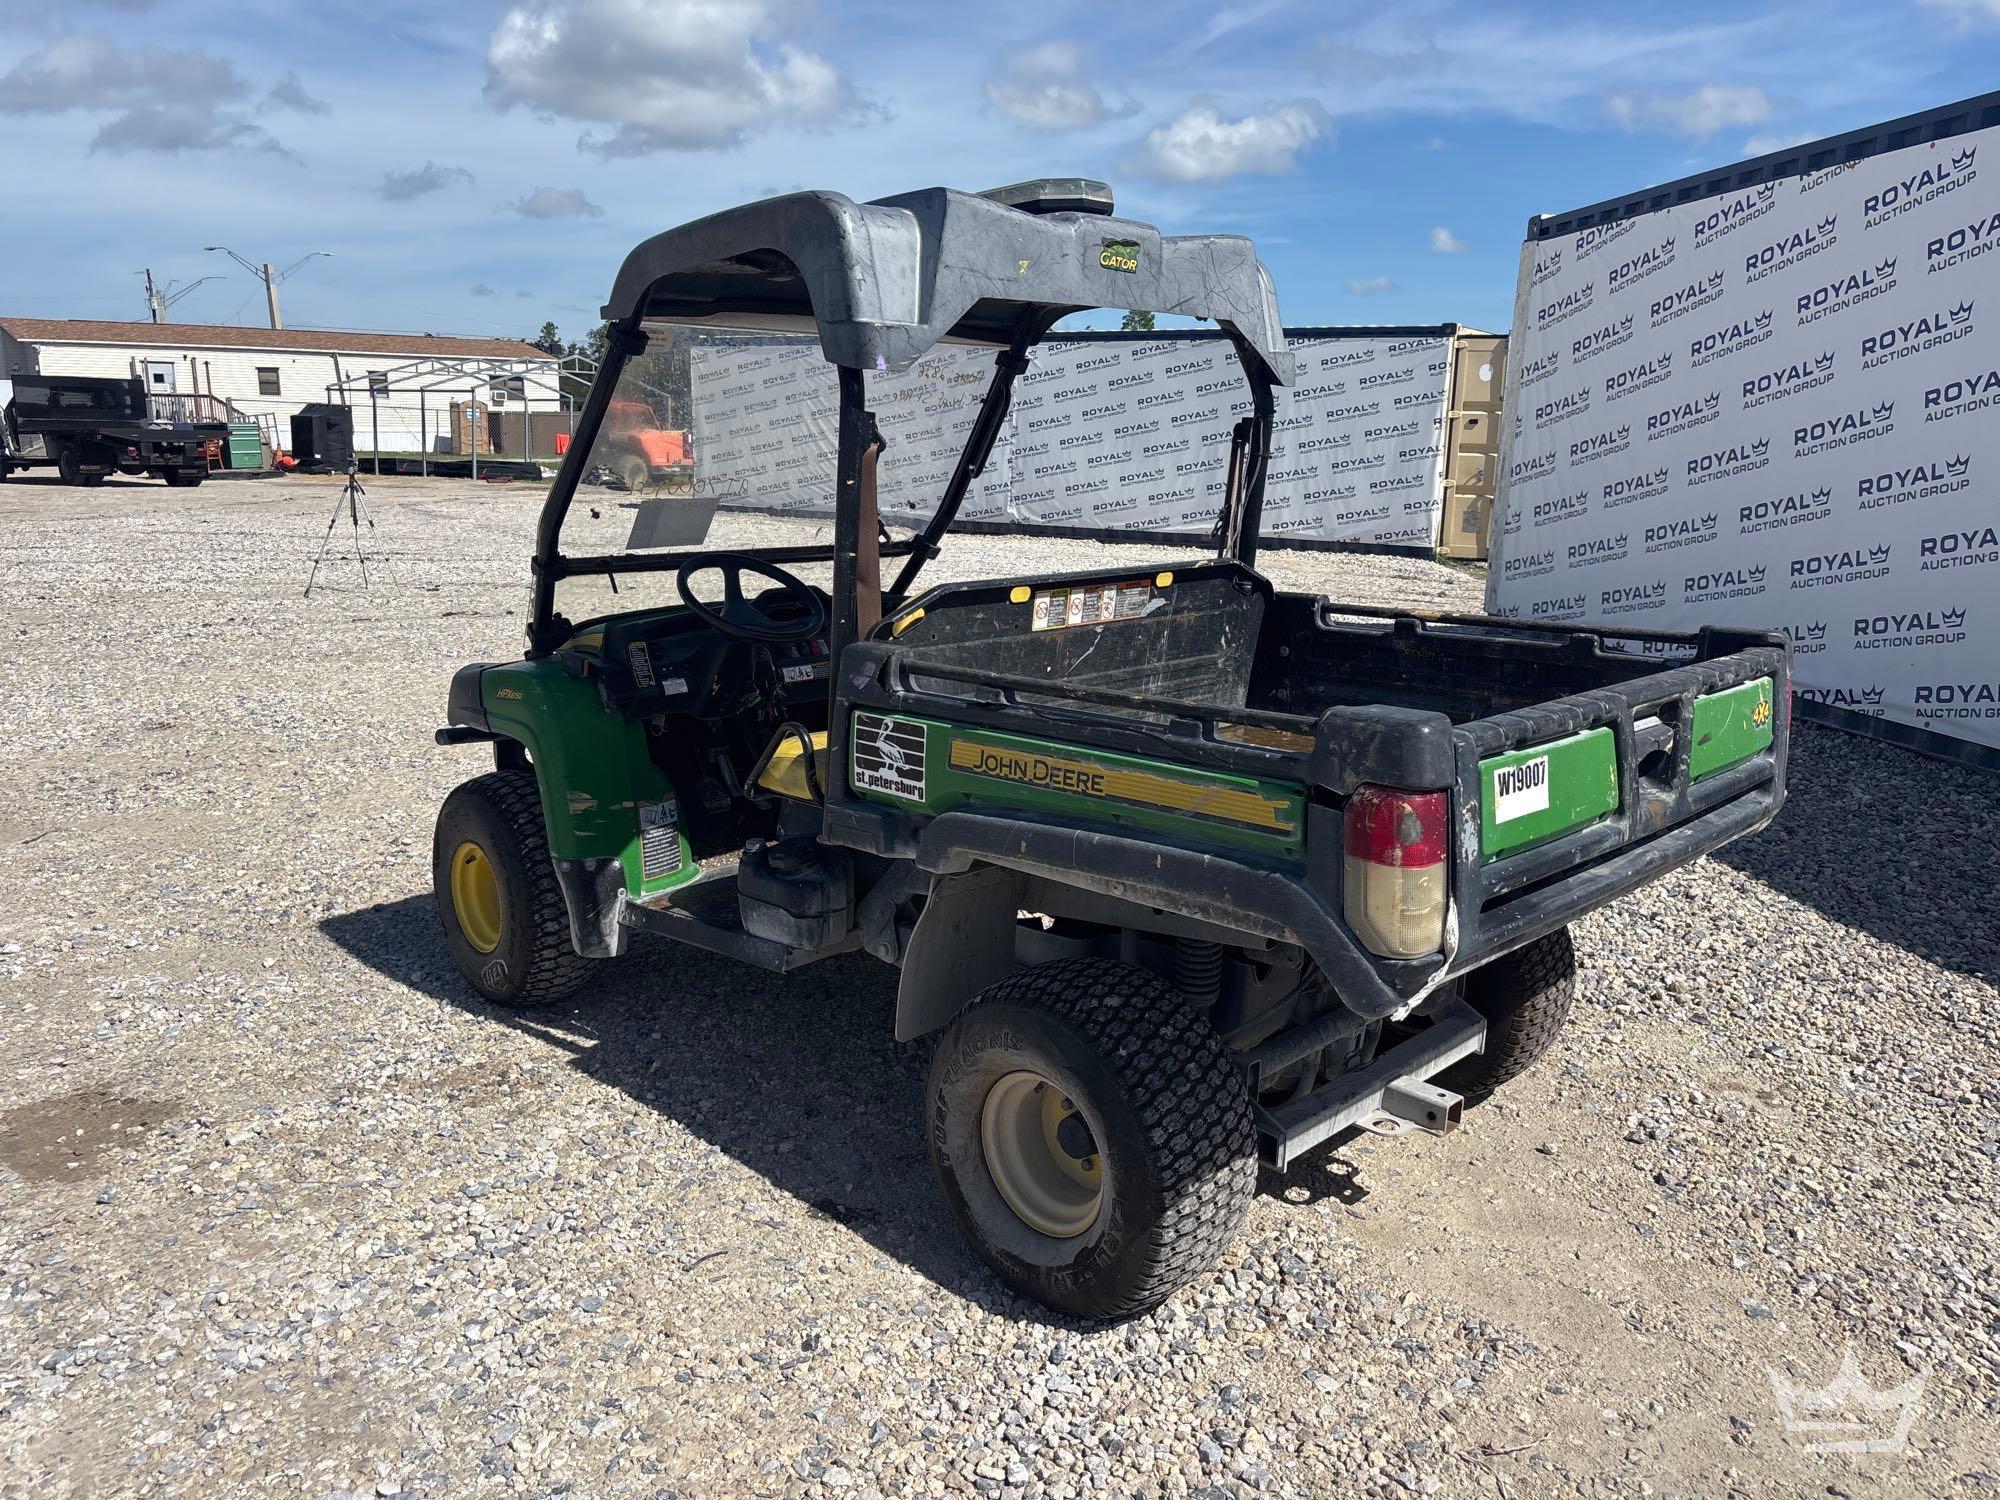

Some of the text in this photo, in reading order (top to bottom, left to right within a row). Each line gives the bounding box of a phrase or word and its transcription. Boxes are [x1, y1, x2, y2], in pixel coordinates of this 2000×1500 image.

[1864, 163, 1950, 216] ROYAL
[1864, 170, 1976, 230] AUCTION GROUP
[1694, 194, 1756, 238] ROYAL
[1694, 201, 1774, 250] AUCTION GROUP
[1576, 221, 1636, 261] AUCTION GROUP
[1746, 227, 1816, 272] ROYAL
[1928, 213, 2000, 260] ROYA
[1100, 251, 1138, 271] GATOR
[1609, 247, 1660, 285] ROYAL
[1746, 235, 1836, 285] AUCTION GROUP
[1928, 240, 1993, 275] AUCTION
[1538, 266, 1561, 283] GROUP
[1609, 254, 1675, 295] AUCTION GROUP
[1650, 280, 1707, 318] ROYAL
[1797, 269, 1874, 313] ROYAL
[1798, 279, 1897, 326] AUCTION GROUP
[1538, 290, 1581, 323] ROYAL
[1538, 298, 1593, 332] AUCTION GROUP
[1650, 288, 1723, 329] AUCTION GROUP
[1572, 323, 1619, 355] ROYAL
[1690, 320, 1753, 357] ROYAL
[1861, 313, 1947, 356] ROYAL
[1862, 324, 1973, 370] AUCTION GROUP
[1321, 352, 1363, 366] ROYAL
[1572, 331, 1633, 365] AUCTION GROUP
[1690, 329, 1772, 369] AUCTION GROUP
[1076, 357, 1111, 369] ROYAL
[1165, 361, 1202, 374] ROYAL
[1521, 358, 1547, 379] YAL
[1606, 360, 1656, 392] ROYAL
[1196, 379, 1234, 392] ROYAL
[1359, 371, 1402, 385] ROYAL
[1606, 370, 1671, 403] AUCTION GROUP
[1743, 361, 1813, 398] ROYAL
[1743, 372, 1834, 410] AUCTION GROUP
[1925, 371, 2000, 409] ROYA
[1054, 386, 1088, 399] ROYAL
[1137, 392, 1174, 405] ROYAL
[1293, 385, 1334, 398] ROYAL
[1326, 405, 1368, 418] ROYAL
[1535, 393, 1577, 420] ROYAL
[1535, 403, 1589, 430] AUCTION GROUP
[1647, 399, 1703, 430] ROYAL
[1925, 397, 1989, 423] AUCTION
[1029, 416, 1062, 428] ROYAL
[1114, 422, 1149, 434] ROYAL
[1365, 424, 1407, 437] ROYAL
[1647, 410, 1719, 442] AUCTION GROUP
[1794, 410, 1871, 445] ROYAL
[1570, 430, 1616, 457] ROYAL
[1794, 423, 1893, 458] AUCTION GROUP
[1088, 452, 1122, 464] ROYAL
[1177, 460, 1213, 471] ROYAL
[1332, 457, 1373, 469] ROYAL
[1570, 441, 1630, 467] AUCTION GROUP
[1687, 445, 1750, 475] ROYAL
[1370, 477, 1412, 489] ROYAL
[1603, 473, 1653, 498] ROYAL
[1687, 458, 1769, 487] AUCTION GROUP
[1858, 462, 1944, 496] ROYAL
[1065, 481, 1099, 492] ROYAL
[1603, 485, 1668, 509] AUCTION GROUP
[1858, 478, 1969, 510] AUCTION GROUP
[1041, 509, 1073, 519] ROYAL
[1093, 500, 1127, 511] ROYAL
[1337, 508, 1378, 520] ROYAL
[1534, 495, 1575, 518] ROYAL
[1534, 507, 1587, 527] AUCTION GROUP
[1740, 493, 1810, 522] ROYAL
[1374, 529, 1417, 540] ROYAL
[1644, 518, 1700, 542] ROYAL
[1740, 508, 1831, 535] AUCTION GROUP
[1568, 537, 1614, 559] ROYAL
[1645, 532, 1716, 554] AUCTION GROUP
[1920, 528, 1999, 557] ROYA
[1505, 553, 1543, 572] ROYAL
[1568, 550, 1628, 569] AUCTION GROUP
[1791, 549, 1867, 576] ROYAL
[1920, 553, 1985, 571] AUCTION
[1505, 565, 1554, 581] AUCTION GROUP
[1684, 569, 1747, 592] ROYAL
[1790, 567, 1890, 589] AUCTION GROUP
[1532, 597, 1573, 614] ROYAL
[1601, 584, 1651, 604] ROYAL
[1602, 599, 1666, 615] AUCTION GROUP
[1684, 585, 1765, 604] AUCTION GROUP
[1854, 611, 1939, 636] ROYAL
[1793, 643, 1826, 654] ROUP
[1854, 632, 1965, 649] AUCTION GROUP
[1915, 684, 2000, 703] ROYA
[1916, 708, 1981, 718] AUCTION
[973, 749, 1105, 793] JOHN DEERE
[1498, 760, 1546, 797] W19007
